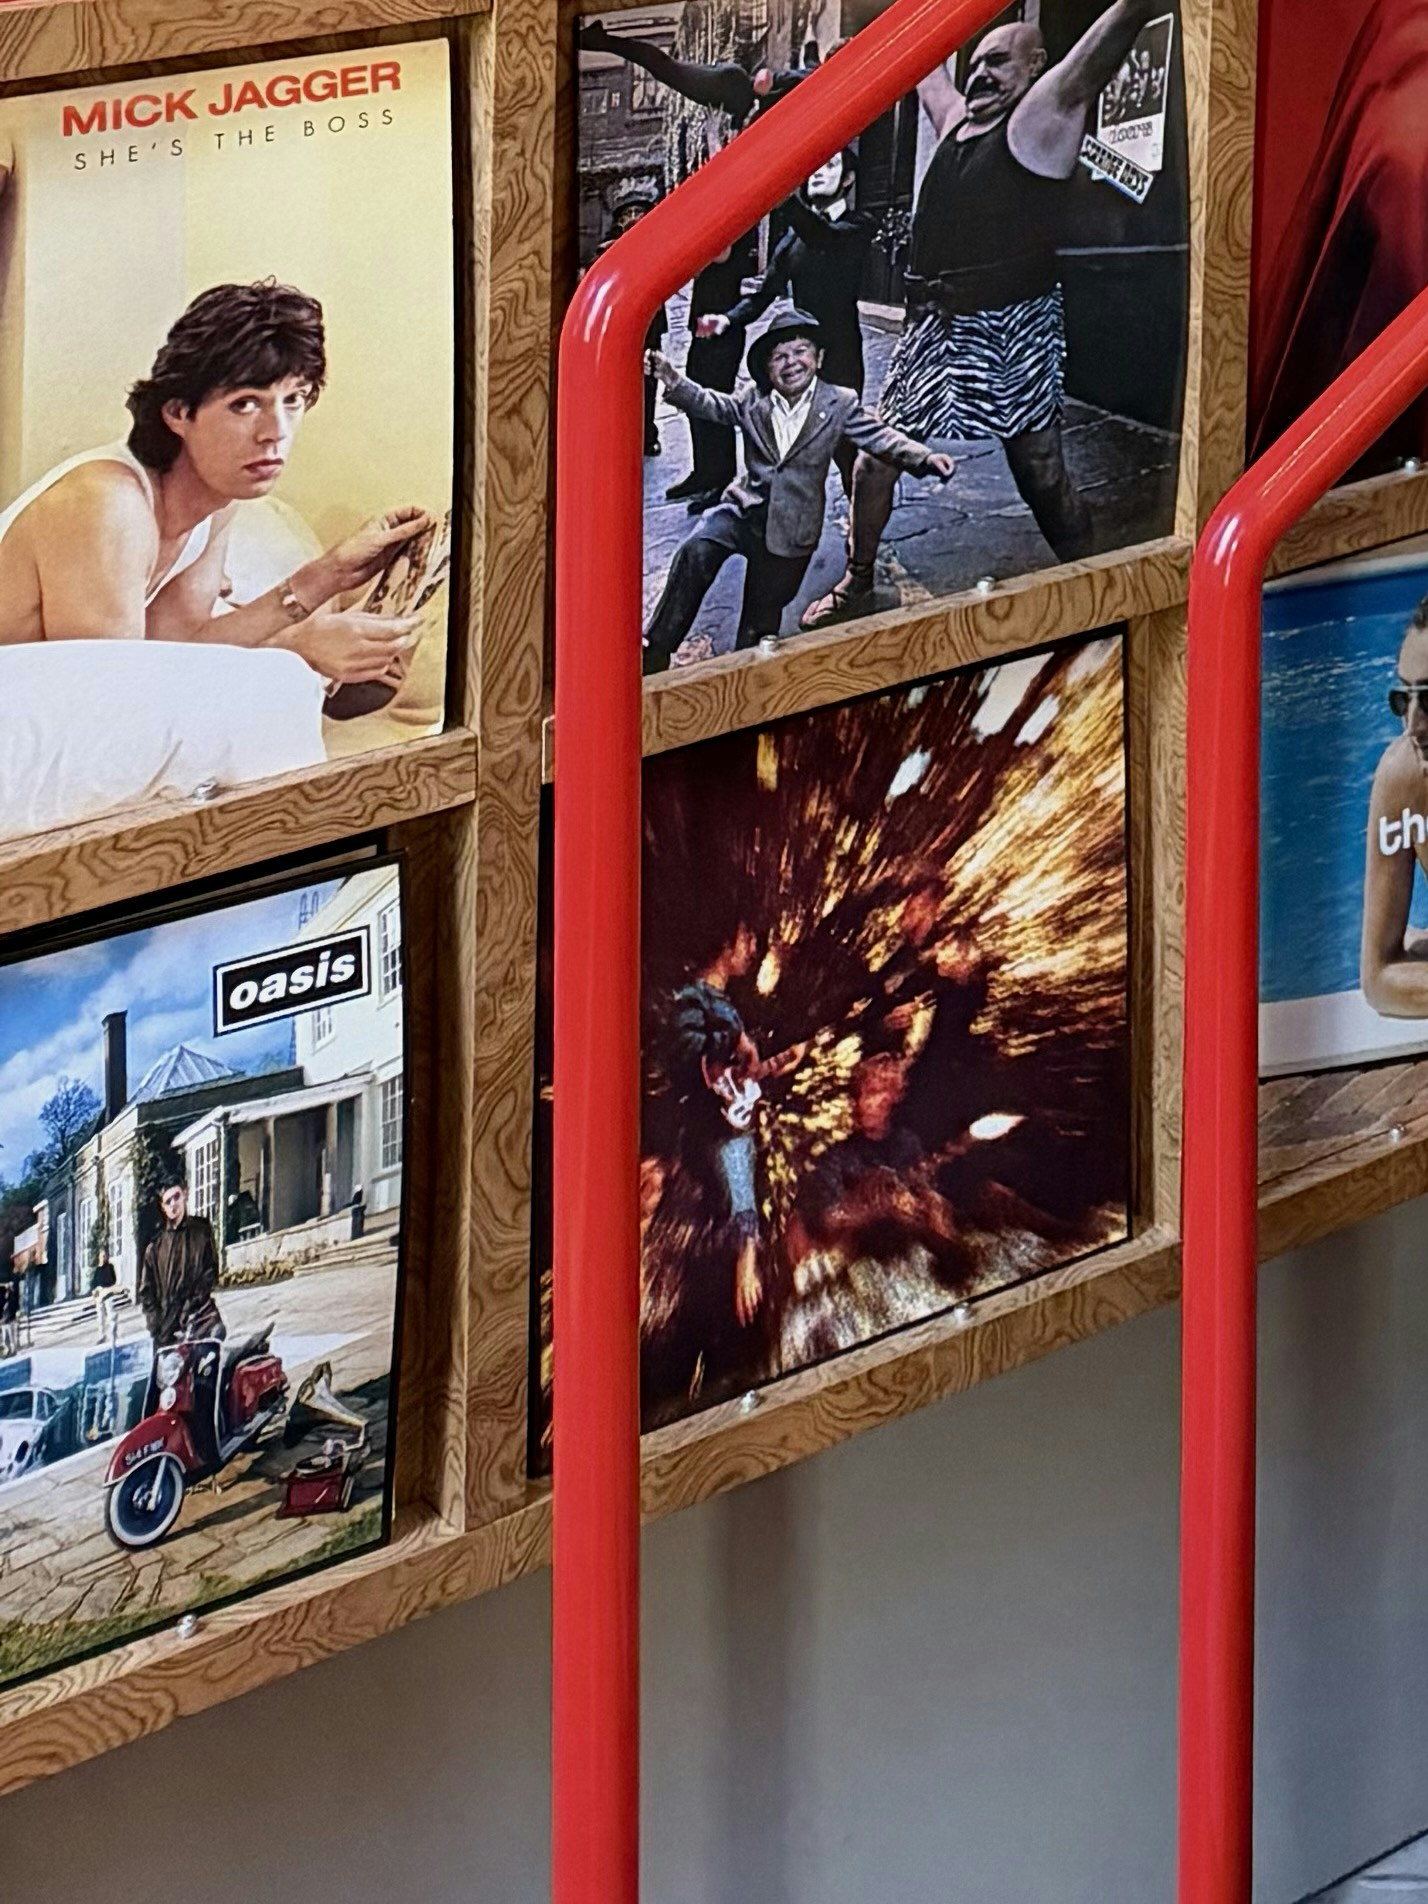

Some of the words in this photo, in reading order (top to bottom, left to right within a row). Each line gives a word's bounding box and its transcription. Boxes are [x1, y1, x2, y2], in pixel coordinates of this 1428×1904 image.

[61, 88, 199, 138] MICK
[208, 60, 402, 119] JAGGER
[74, 139, 184, 171] SHE'S
[213, 123, 277, 152] THE
[304, 107, 395, 138] BOSS
[228, 950, 357, 1013] oasis
